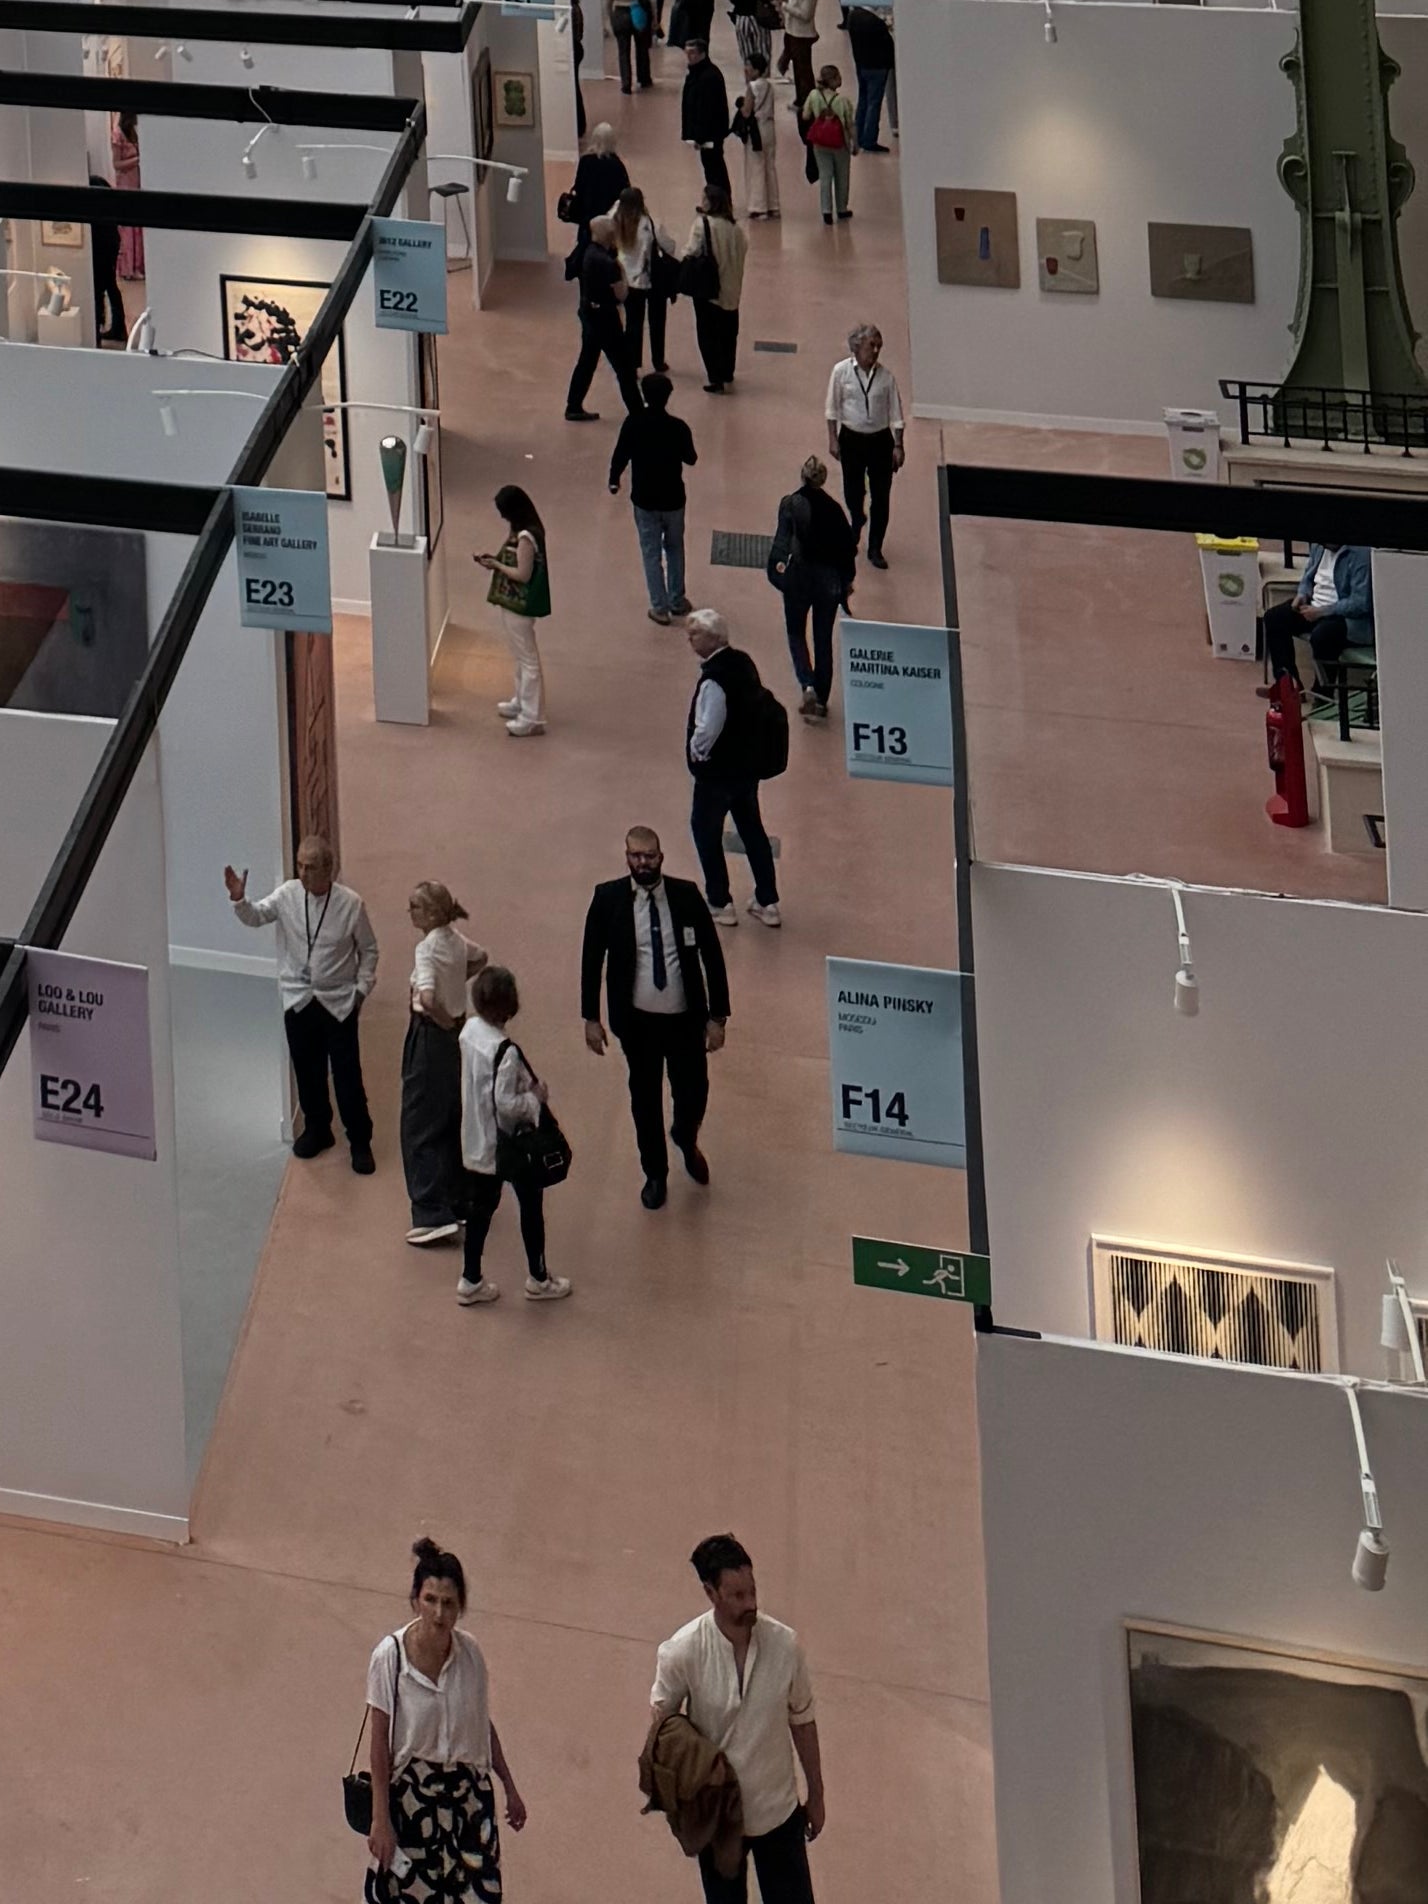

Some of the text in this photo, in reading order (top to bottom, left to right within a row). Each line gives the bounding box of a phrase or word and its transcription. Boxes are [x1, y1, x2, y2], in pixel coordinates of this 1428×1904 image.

[379, 289, 419, 313] E22
[281, 538, 318, 551] GALLERY
[245, 577, 295, 607] E23
[849, 647, 894, 663] GALERIE
[850, 661, 941, 680] MARTINA KAISER
[852, 722, 908, 756] F13
[38, 983, 104, 1007] LOO & LOU
[838, 990, 934, 1015] ALINA PINSKY
[38, 1000, 94, 1022] GALLERY
[40, 1073, 104, 1118] E24
[841, 1083, 909, 1127] F14
